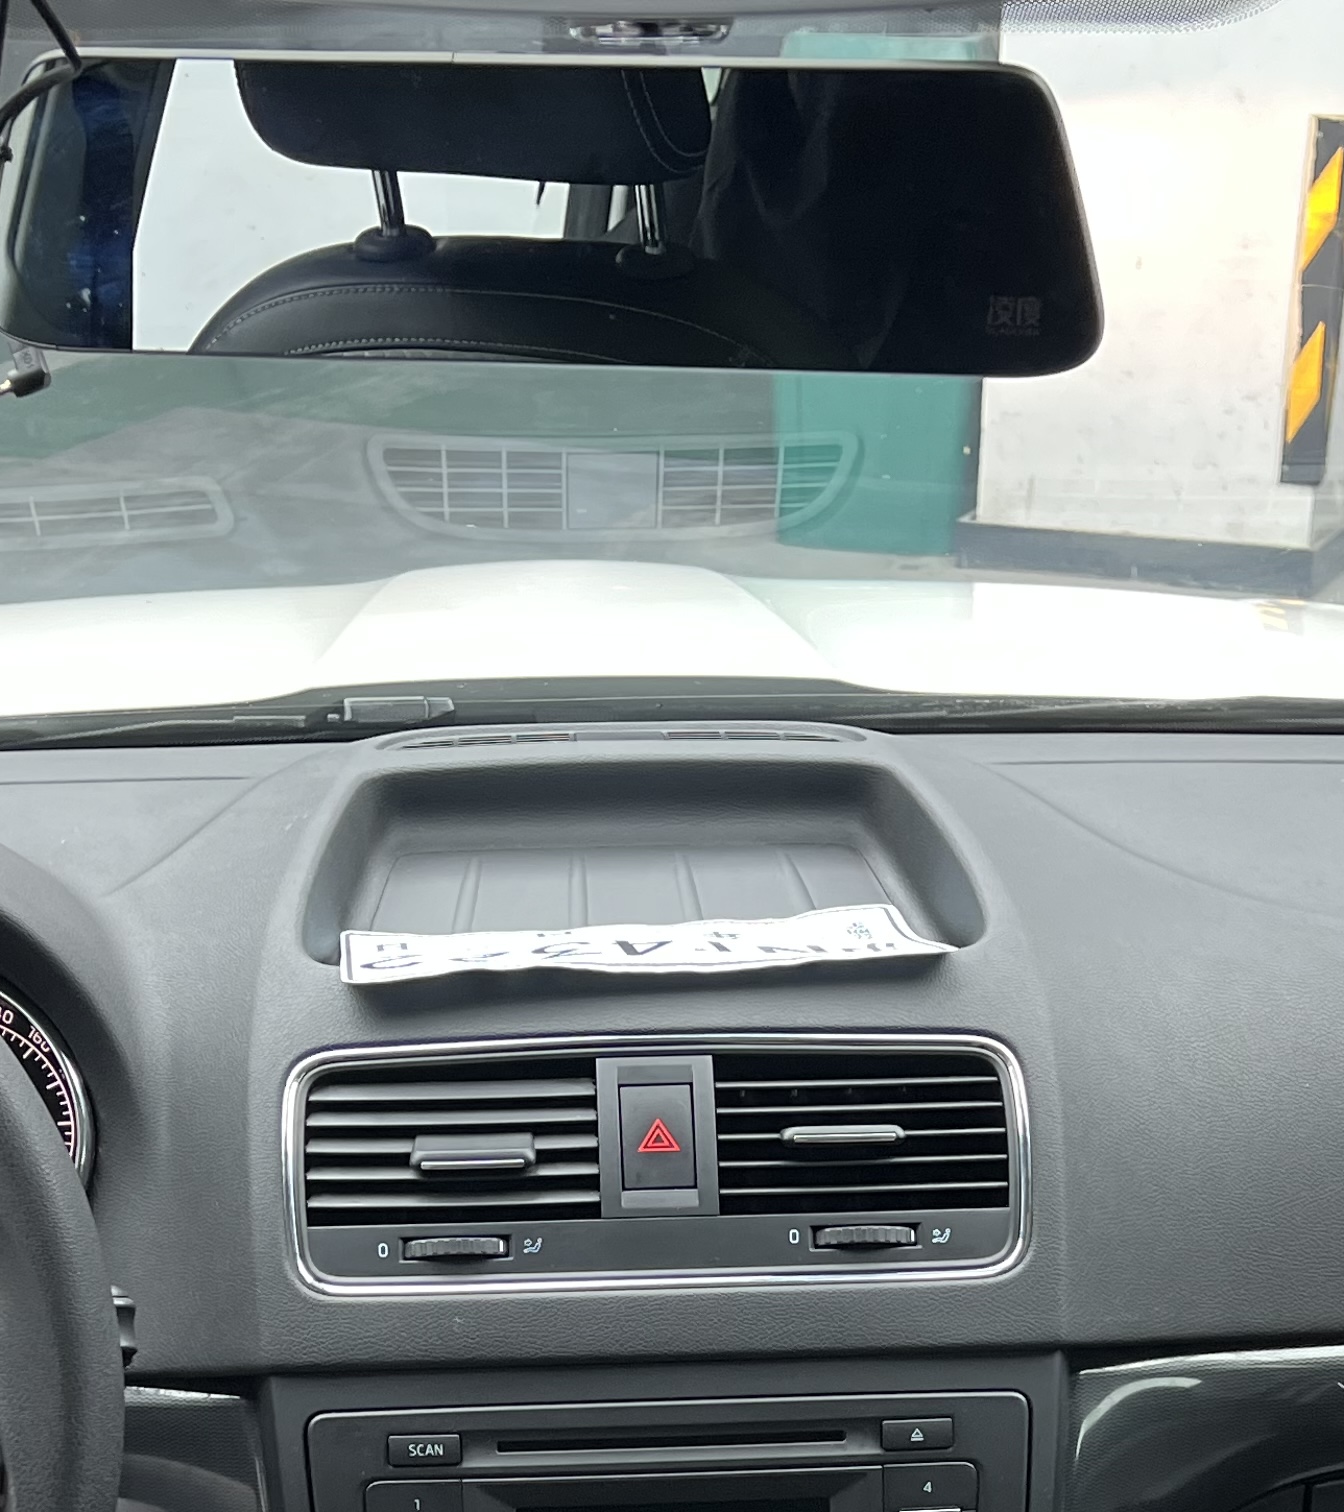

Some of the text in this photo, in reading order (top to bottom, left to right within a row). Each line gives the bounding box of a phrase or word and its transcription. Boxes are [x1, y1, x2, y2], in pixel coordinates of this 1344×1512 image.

[408, 1443, 444, 1457] SCAN
[922, 1481, 932, 1493] 4
[414, 1499, 421, 1511] 1
